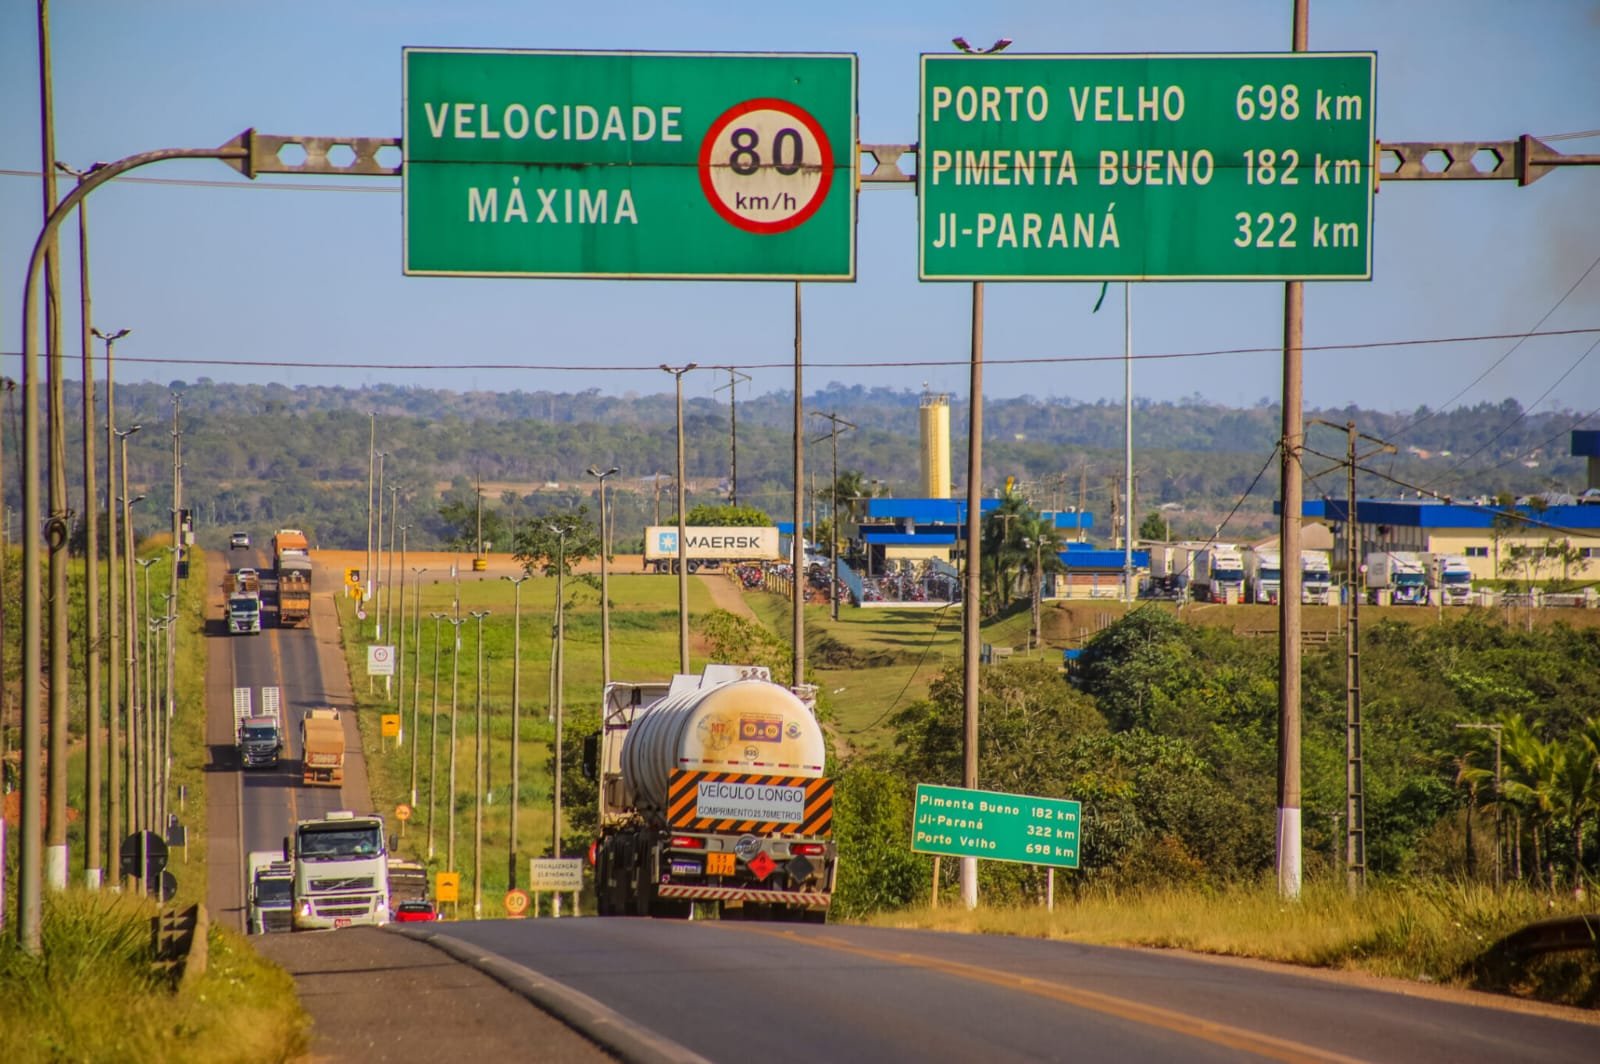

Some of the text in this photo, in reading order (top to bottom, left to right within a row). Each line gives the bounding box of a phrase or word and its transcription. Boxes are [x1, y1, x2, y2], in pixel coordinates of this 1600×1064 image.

[932, 84, 1363, 122] PORTO VELHO 698 km
[424, 102, 683, 142] VELOCIDADE
[729, 128, 803, 176] 80
[932, 149, 1361, 186] PIMENTA BUENO 182 km
[467, 177, 639, 224] MÁXIMA
[735, 192, 797, 211] km/h
[933, 203, 1359, 249] JI-PARANÁ 322 km
[685, 536, 760, 548] MAERSK
[700, 783, 803, 803] VEÍCULO LONGO
[698, 806, 753, 818] COMPRIMENTO
[920, 795, 1076, 821] Pimenta Bueno 182 km
[917, 831, 1074, 857] Porto Velho 698 km
[1027, 825, 1052, 837] 322
[1056, 829, 1075, 839] km
